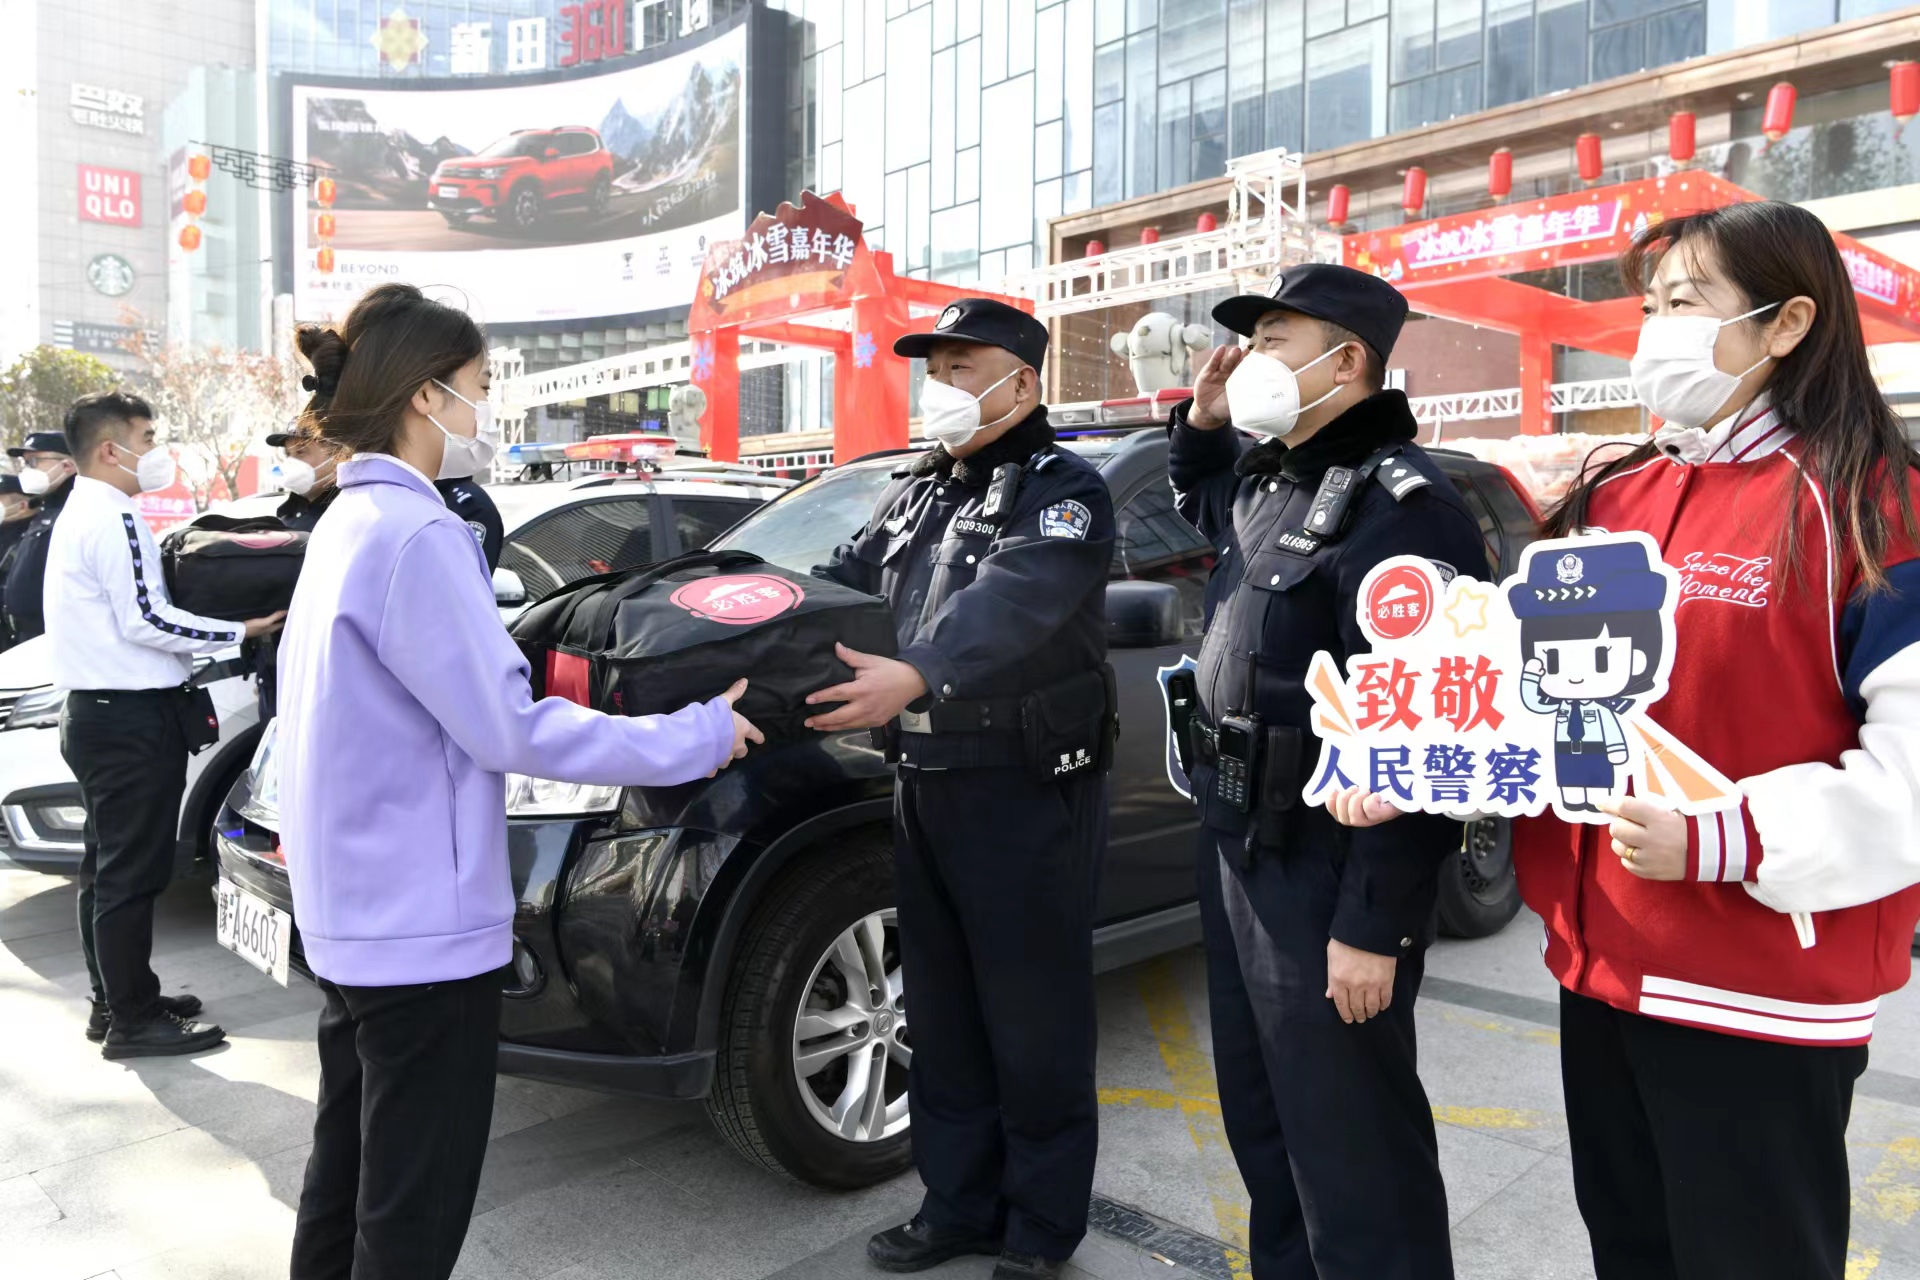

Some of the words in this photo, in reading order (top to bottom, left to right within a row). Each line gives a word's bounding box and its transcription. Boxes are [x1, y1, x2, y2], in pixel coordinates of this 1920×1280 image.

[85, 170, 130, 196] UNI
[85, 194, 135, 220] QLO
[340, 263, 399, 274] BEYOND
[712, 222, 855, 300] 冰筑冰雪嘉年华
[956, 519, 996, 535] 009300
[1279, 532, 1317, 551] 016865
[1677, 551, 1731, 576] Seize
[1712, 552, 1773, 587] The
[711, 586, 781, 612] 必胜客
[1377, 602, 1420, 619] 必胜客
[1356, 655, 1505, 732] 致敬
[1054, 755, 1091, 775] POLICE
[1311, 743, 1541, 805] 人民警察
